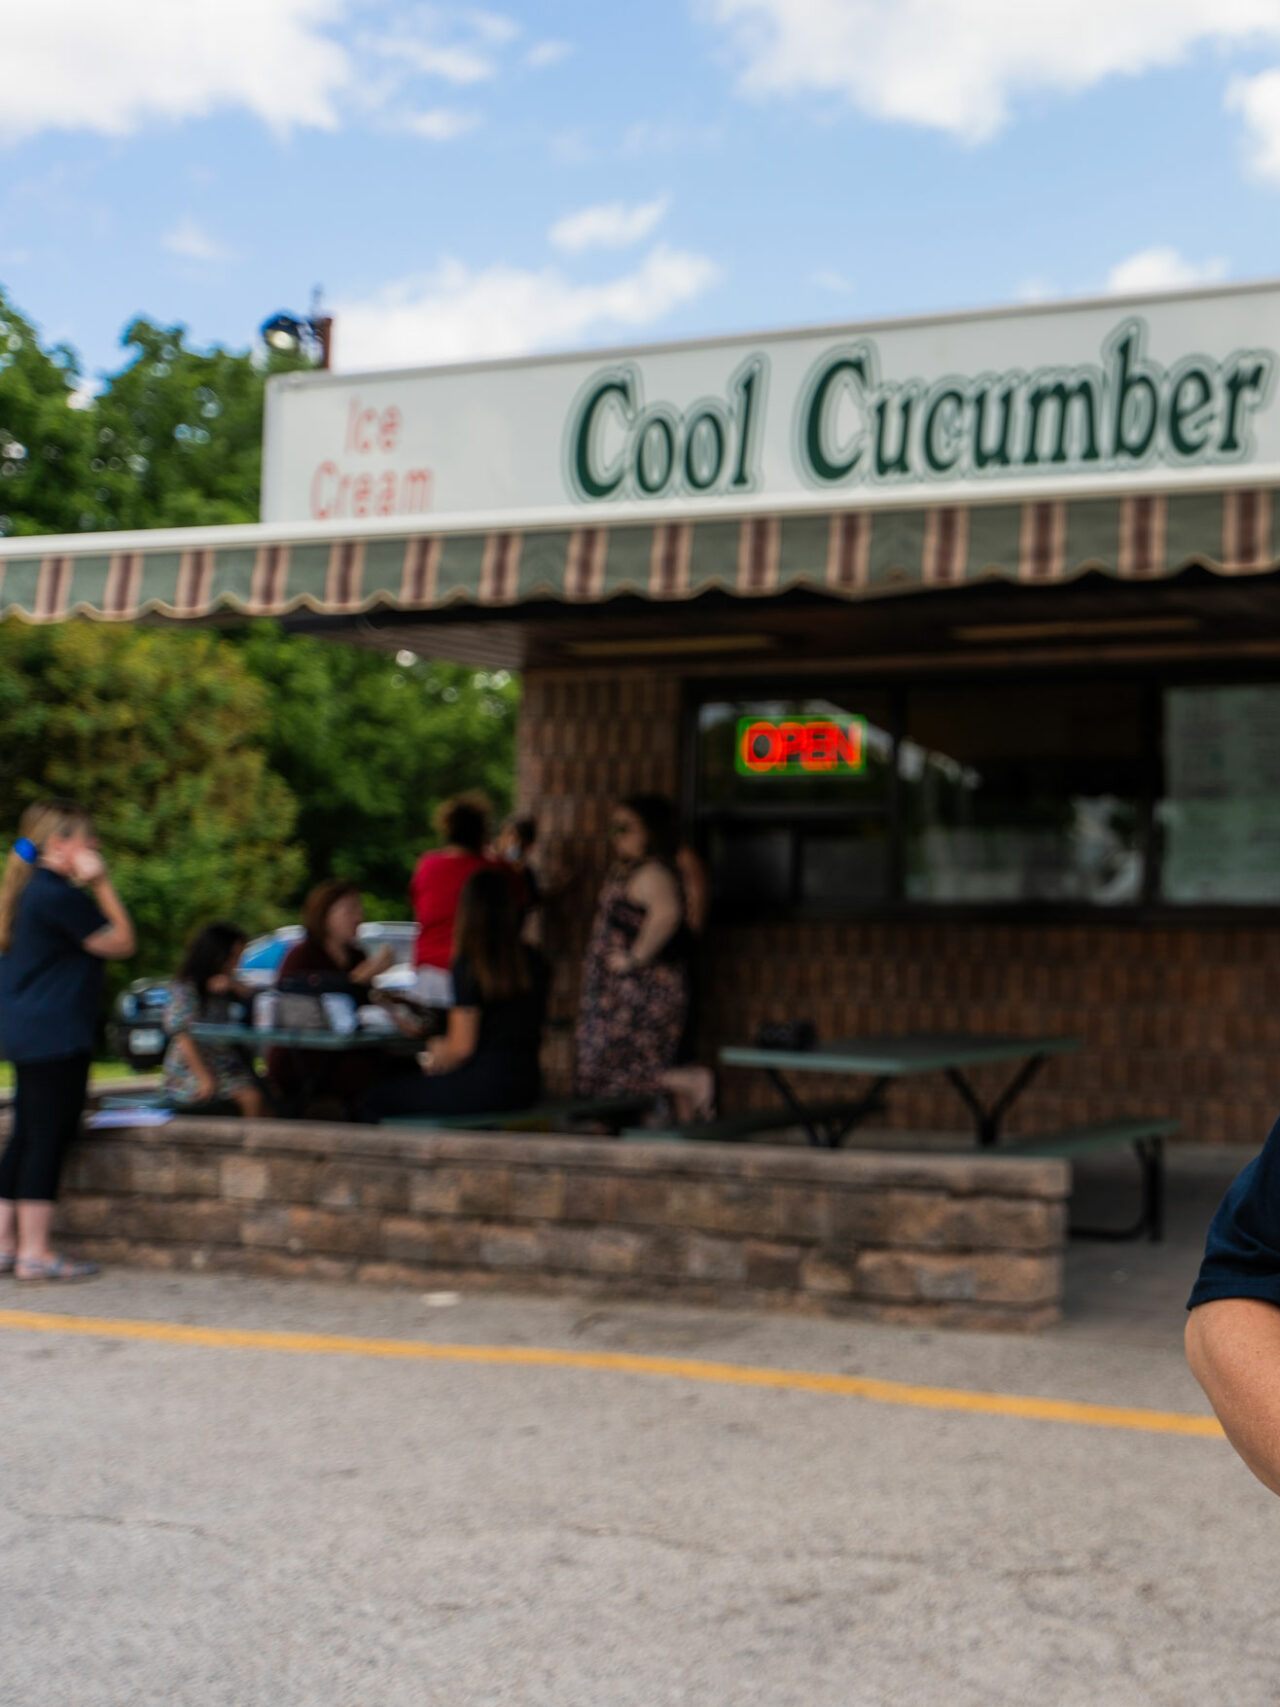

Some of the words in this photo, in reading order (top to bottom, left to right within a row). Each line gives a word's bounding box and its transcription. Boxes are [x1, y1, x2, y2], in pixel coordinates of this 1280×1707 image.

[346, 396, 402, 454] Ice
[566, 357, 766, 501] Cool
[799, 324, 1273, 484] Cucumber
[310, 461, 433, 519] Cream
[742, 721, 863, 772] OPEN
